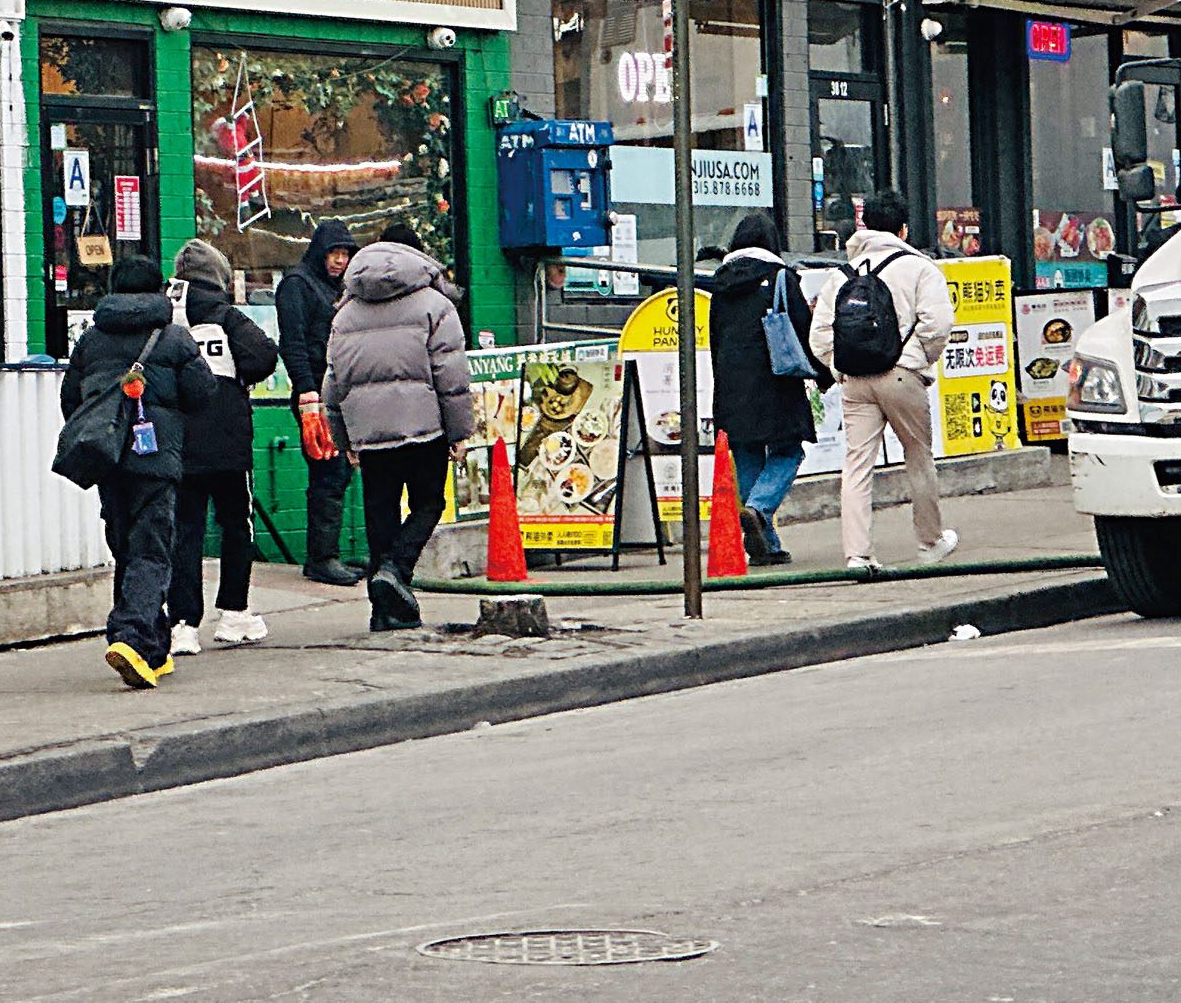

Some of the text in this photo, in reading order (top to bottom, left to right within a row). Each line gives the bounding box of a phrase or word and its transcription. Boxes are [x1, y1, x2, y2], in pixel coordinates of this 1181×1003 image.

[618, 52, 674, 103] OPE
[568, 122, 596, 145] ATM
[69, 157, 85, 190] A
[85, 244, 105, 256] OPEN
[653, 325, 705, 337] HUNY
